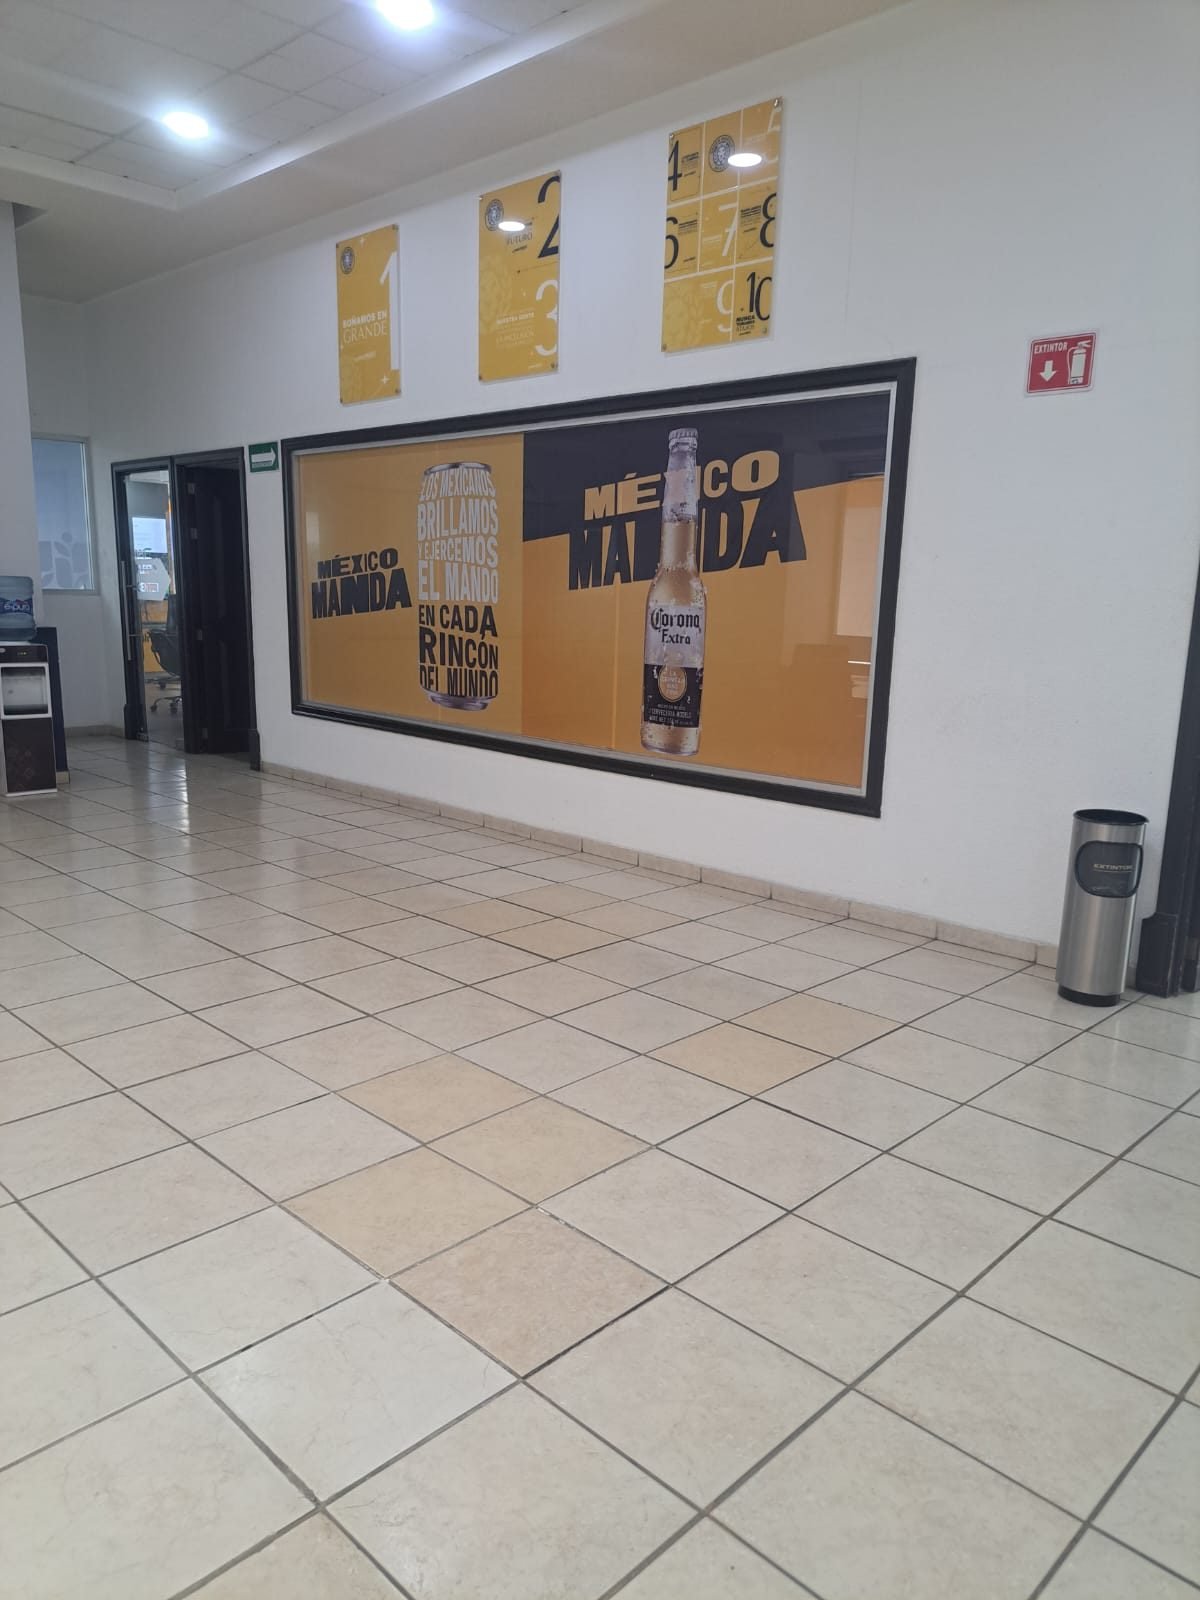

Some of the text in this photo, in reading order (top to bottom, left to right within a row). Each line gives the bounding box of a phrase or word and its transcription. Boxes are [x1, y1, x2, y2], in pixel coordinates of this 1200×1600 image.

[537, 175, 560, 259] 2
[379, 251, 400, 371] 1
[747, 272, 772, 321] 10
[343, 321, 387, 344] GRANDE
[535, 279, 558, 358] 3
[1034, 342, 1068, 354] EXTINTOR
[420, 466, 496, 501] LOS MEXICANOS
[584, 450, 780, 520] MÉICO
[417, 498, 498, 541] BRILLAMOS
[317, 547, 399, 579] MÉXICO
[424, 536, 498, 568] EJERCEMOS
[311, 567, 412, 619] MANDA
[418, 560, 498, 604] EL MANDO
[419, 604, 498, 637] EN CADA
[651, 608, 701, 634] Corona
[662, 629, 691, 645] Extra
[419, 626, 498, 669] RINCÓN
[447, 667, 498, 698] MUNDO
